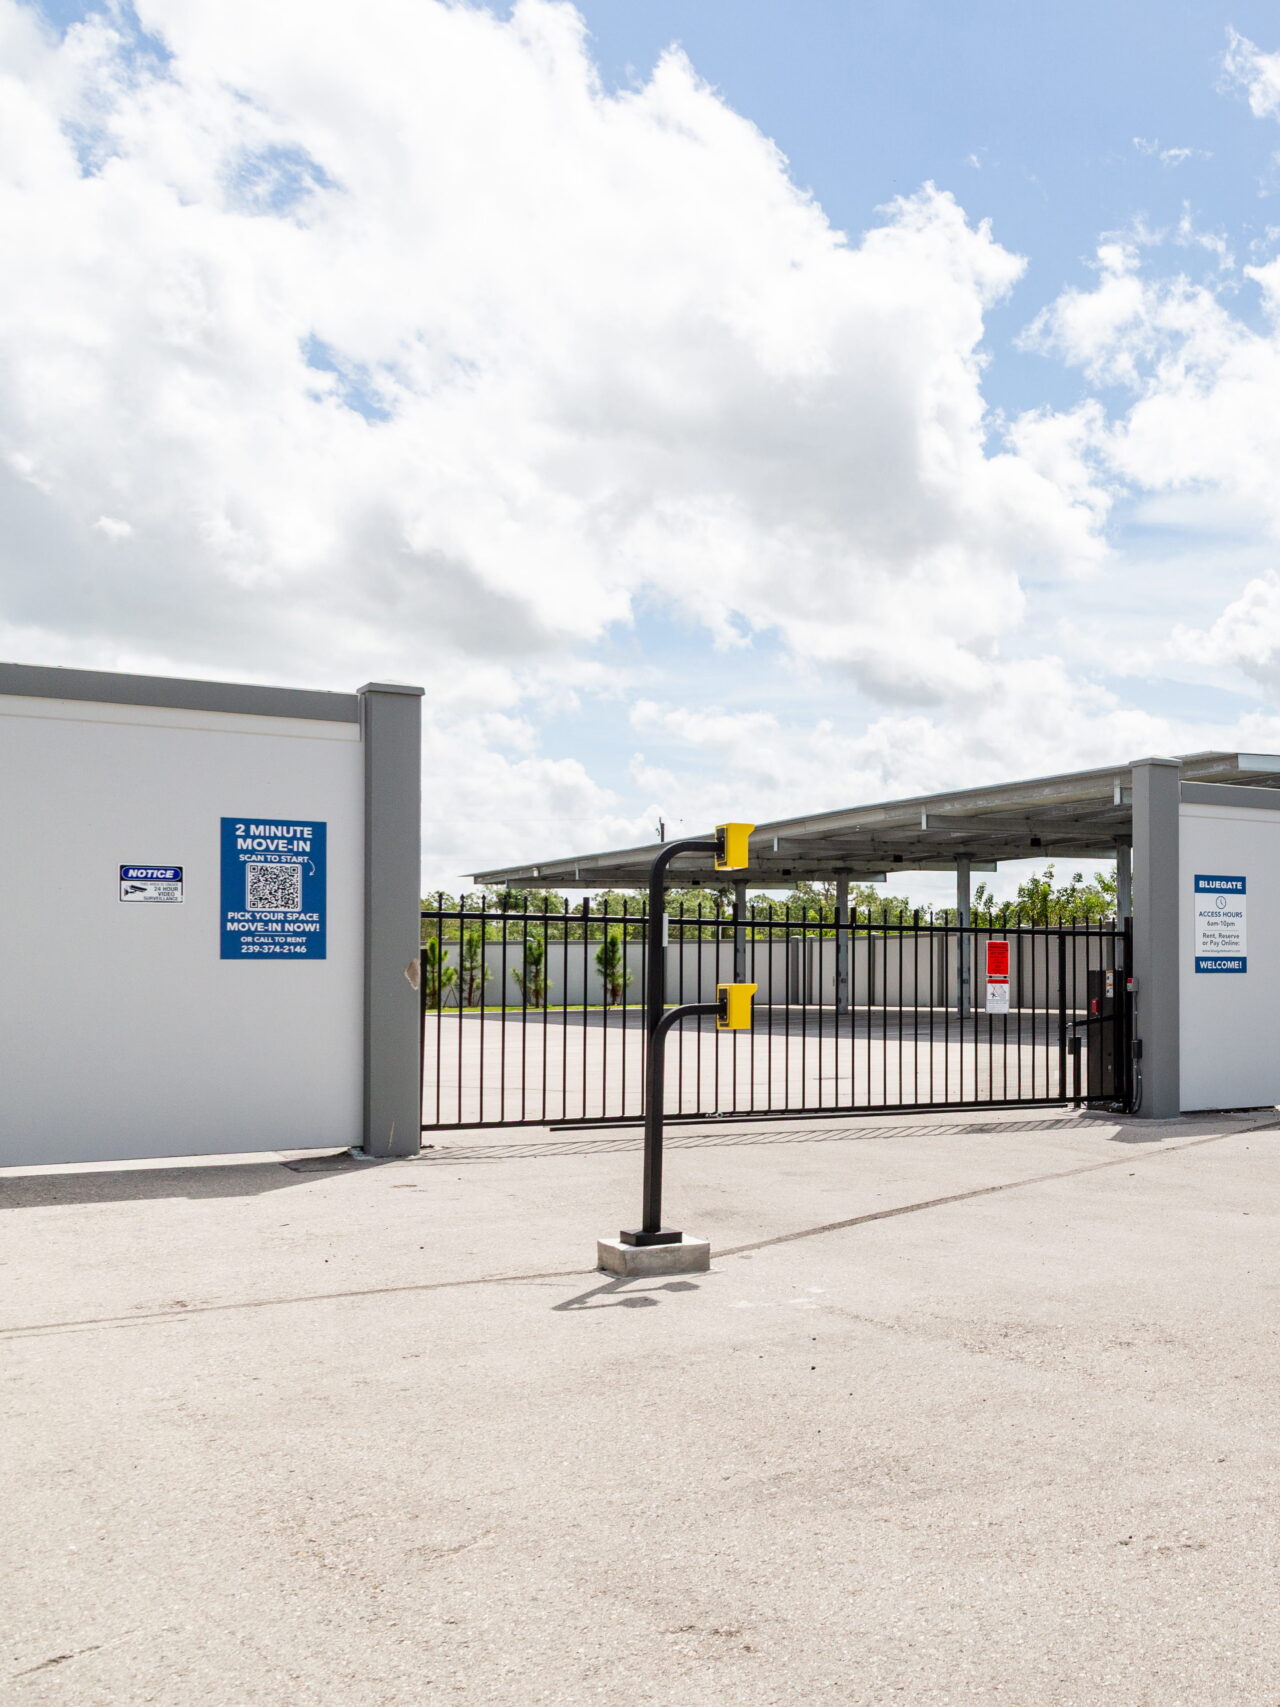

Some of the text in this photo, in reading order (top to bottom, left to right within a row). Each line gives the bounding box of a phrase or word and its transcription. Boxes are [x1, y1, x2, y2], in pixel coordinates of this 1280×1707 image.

[235, 824, 313, 838] 2 MINUTE
[236, 838, 311, 852] MOVE-IN
[239, 854, 265, 862] SCAN
[281, 855, 309, 863] START
[128, 869, 175, 878] NOTICE
[1199, 880, 1243, 889] BLUEGATE
[227, 912, 319, 921] PICK YOUR SPACE
[226, 922, 320, 932] MOVE-IN NOW!
[241, 945, 307, 953] 239-374-2146
[1200, 960, 1242, 969] WELCOME!
